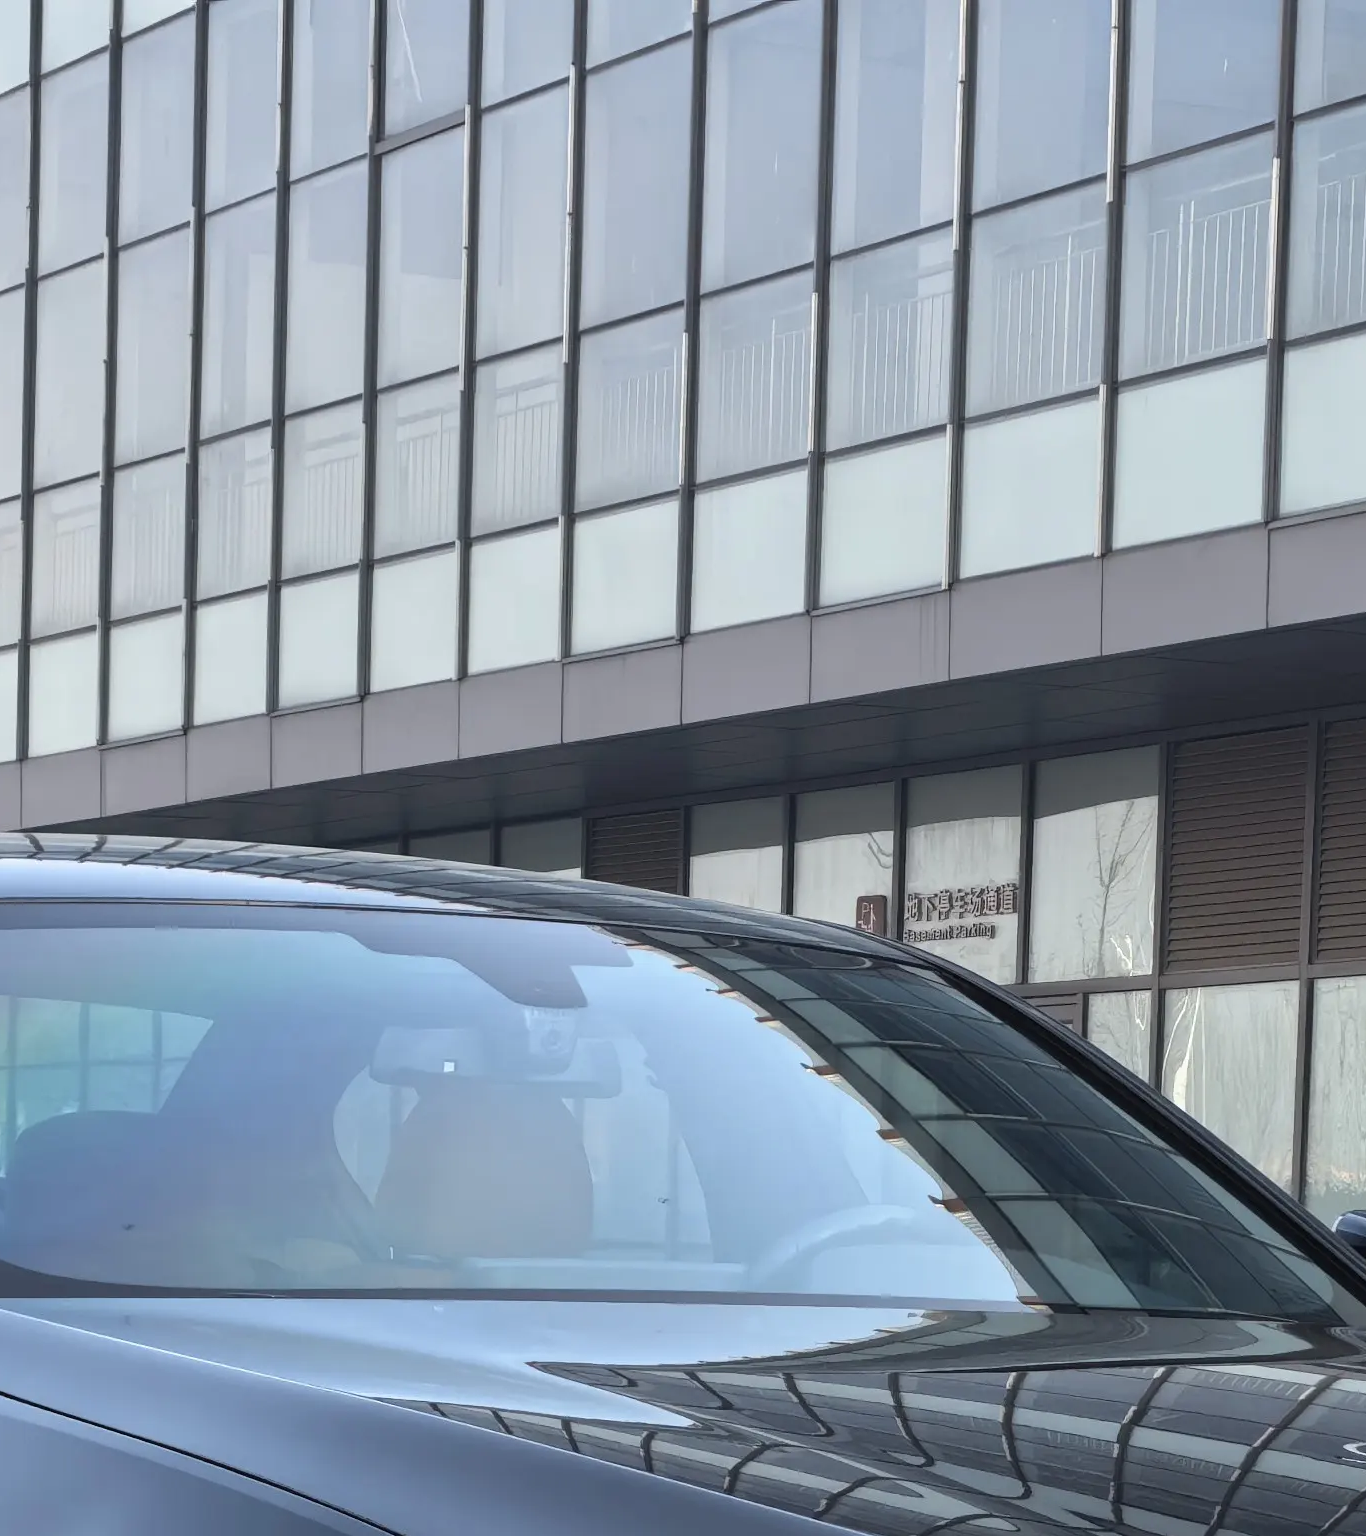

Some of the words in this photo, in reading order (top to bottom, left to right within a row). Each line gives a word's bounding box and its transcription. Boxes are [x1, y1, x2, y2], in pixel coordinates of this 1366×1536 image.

[904, 883, 1019, 922] 地下停车场通道
[952, 923, 995, 939] Parking
